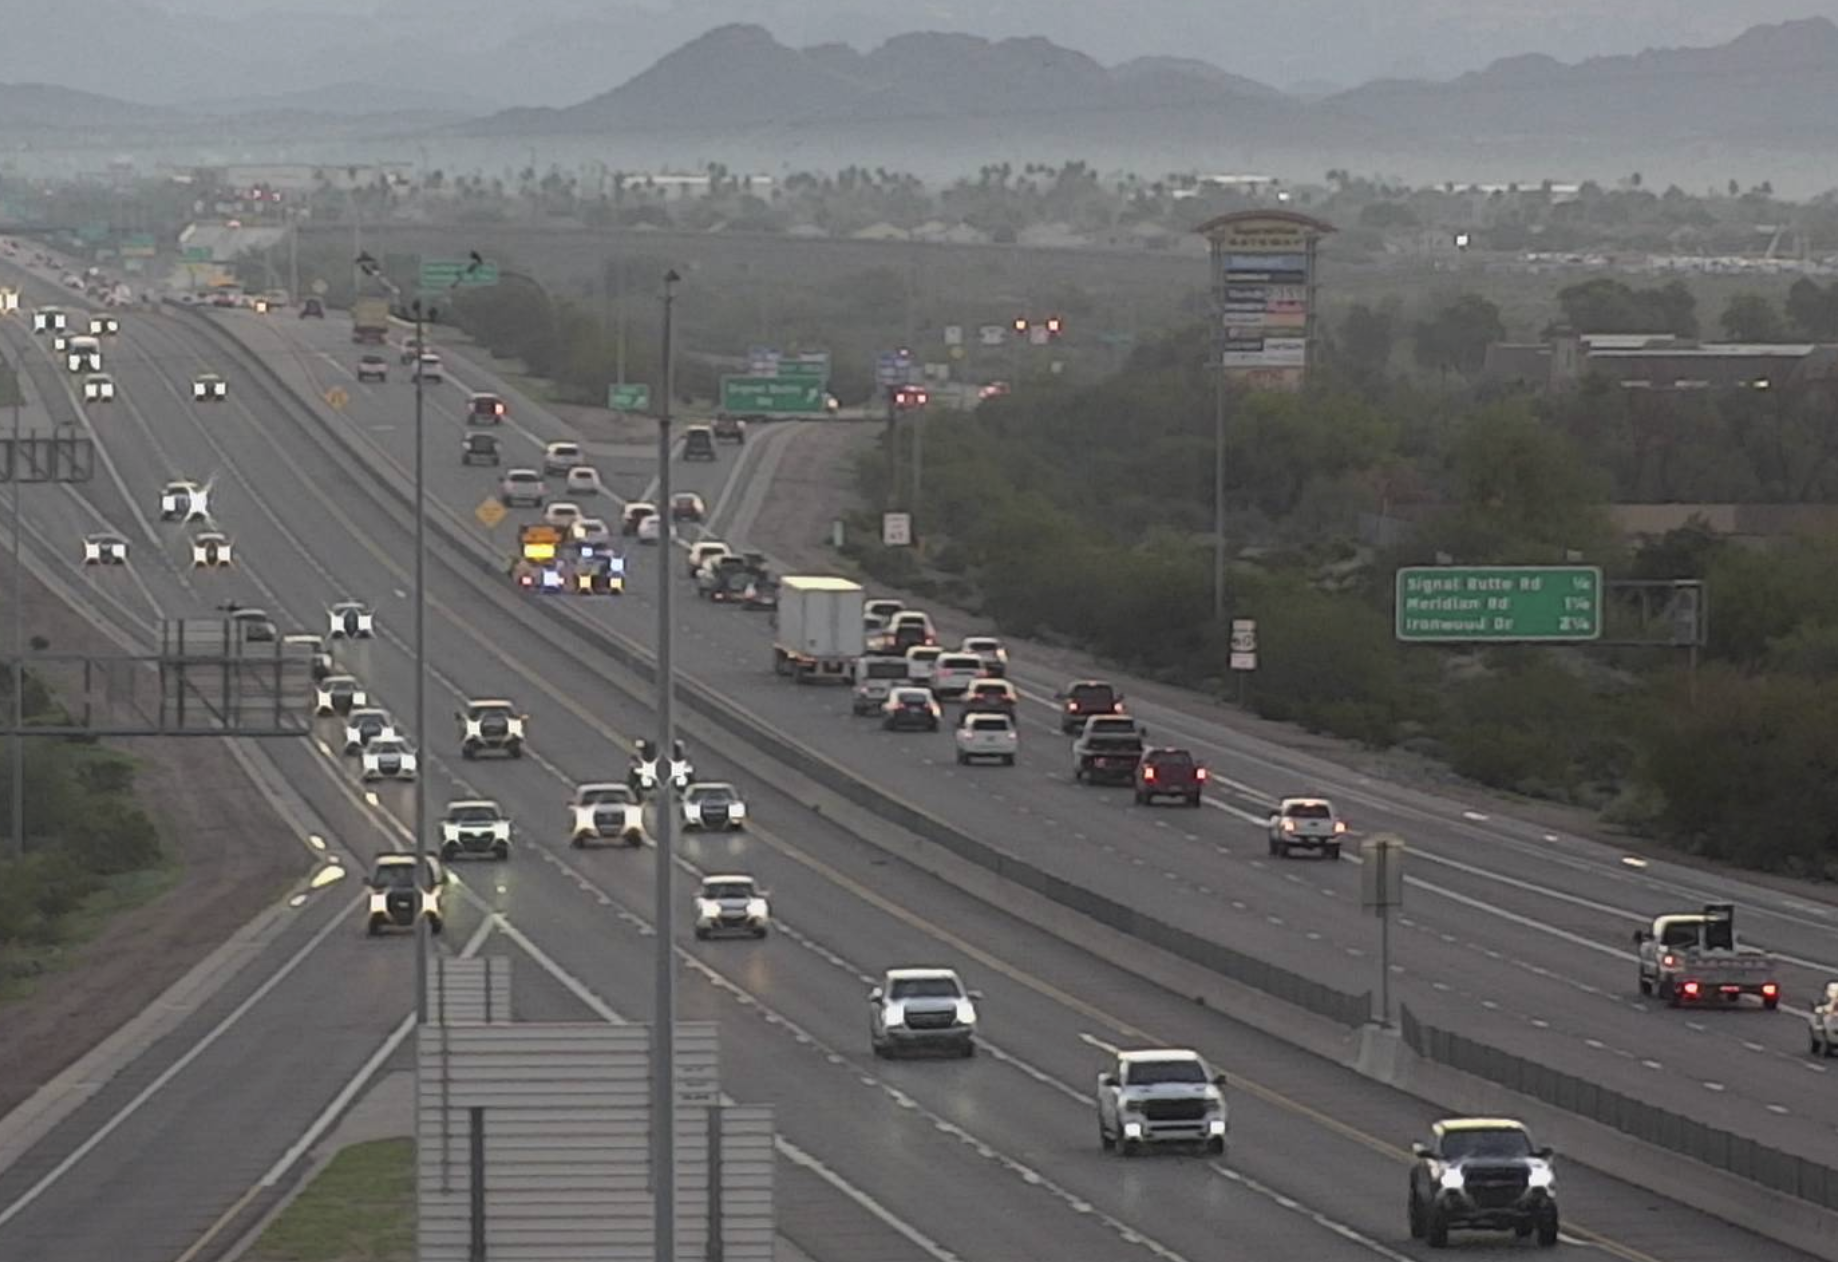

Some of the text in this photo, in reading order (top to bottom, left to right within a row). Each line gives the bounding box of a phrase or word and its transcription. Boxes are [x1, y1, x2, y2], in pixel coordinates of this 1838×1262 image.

[1407, 577, 1459, 594] Signal
[1466, 577, 1513, 590] Butte
[1519, 576, 1541, 590] Rd
[1406, 596, 1479, 609] Meridian
[1487, 596, 1509, 609] Rd
[1406, 616, 1485, 630] Ironwood
[1493, 616, 1515, 630] Dr
